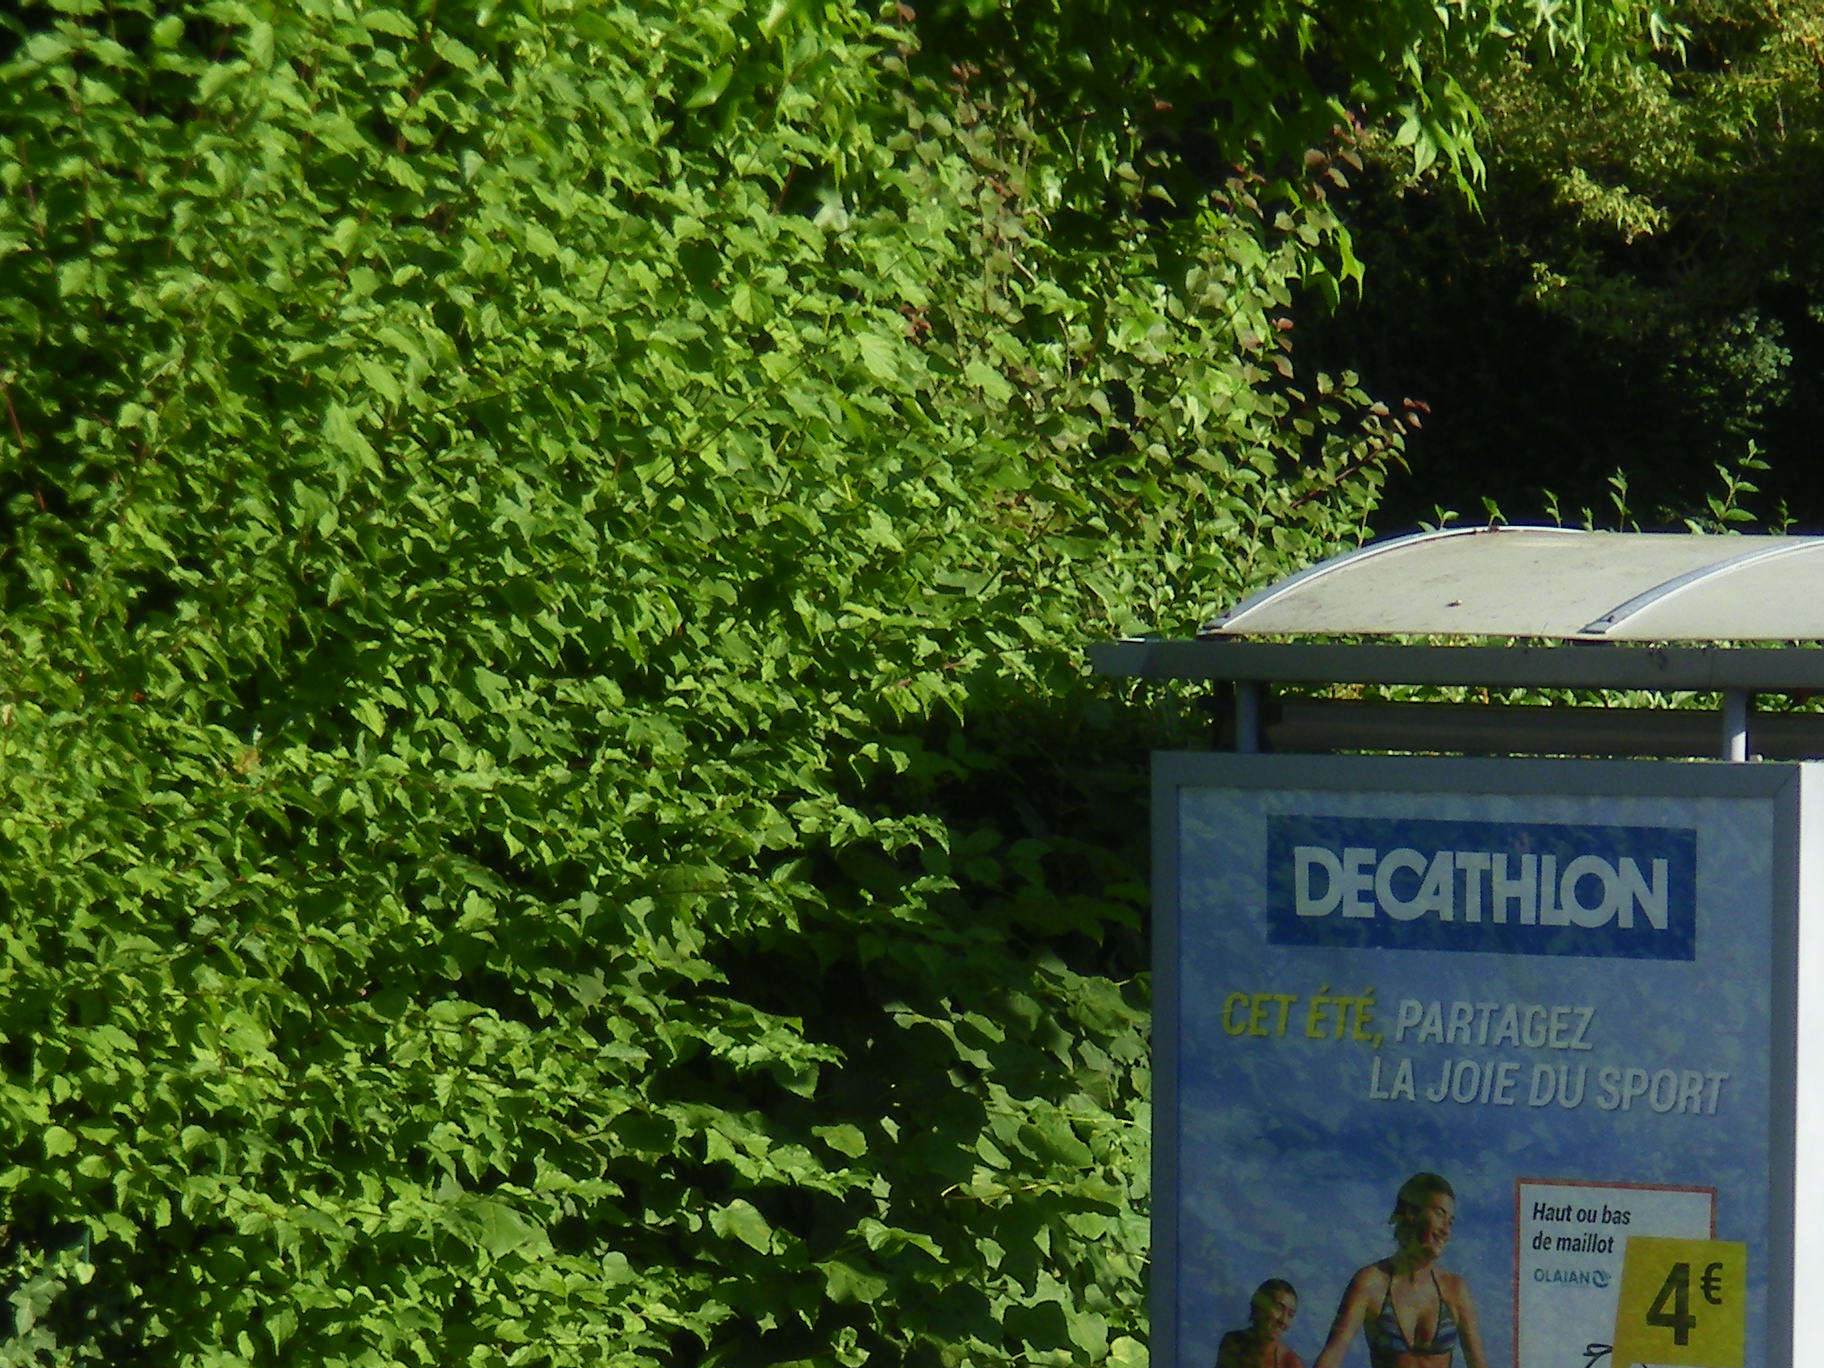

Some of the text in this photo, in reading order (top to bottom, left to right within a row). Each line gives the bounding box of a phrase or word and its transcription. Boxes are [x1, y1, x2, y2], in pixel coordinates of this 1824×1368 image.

[1294, 846, 1669, 930] DECATHLON
[1222, 986, 1596, 1051] CET ÉTÉ, PARTAGEZ
[1369, 1056, 1729, 1116] LA JOIE DU SPORT
[1532, 1202, 1631, 1225] Haut ou bas
[1532, 1230, 1614, 1253] de maillot
